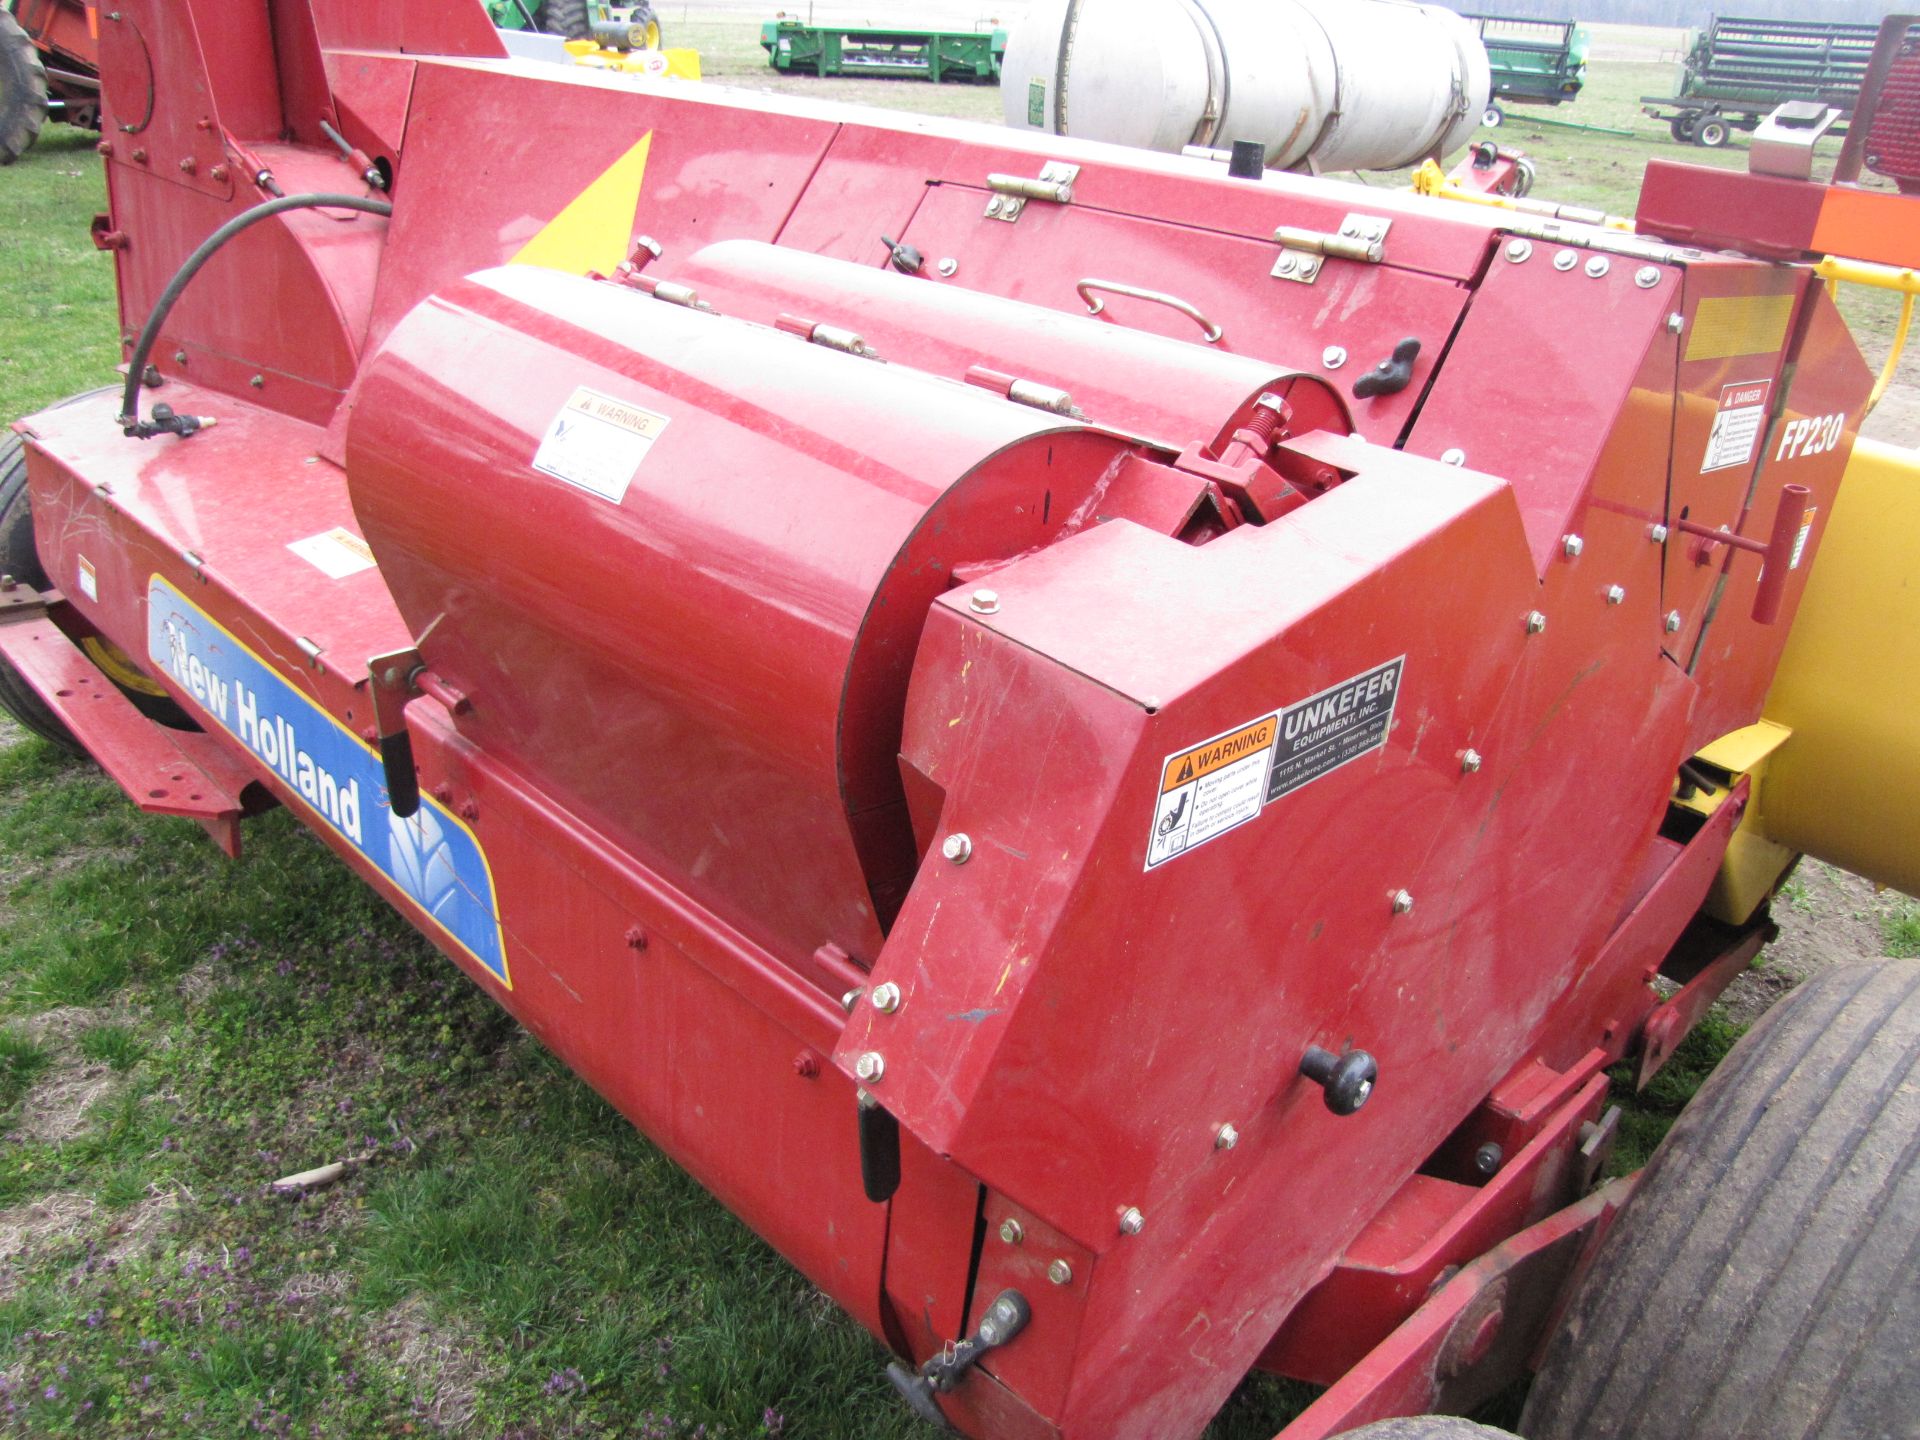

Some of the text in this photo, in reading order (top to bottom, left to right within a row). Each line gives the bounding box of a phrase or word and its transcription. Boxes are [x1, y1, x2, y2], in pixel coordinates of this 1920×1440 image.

[597, 403, 650, 431] WARNING
[1734, 389, 1761, 404] DANGER
[1775, 412, 1845, 462] FP230
[1284, 668, 1395, 740] UNKEFER
[1292, 702, 1378, 752] EQUIPMENT, INC.
[165, 619, 362, 845] New Holland
[1198, 726, 1268, 770] WARNING
[1304, 748, 1327, 765] Market
